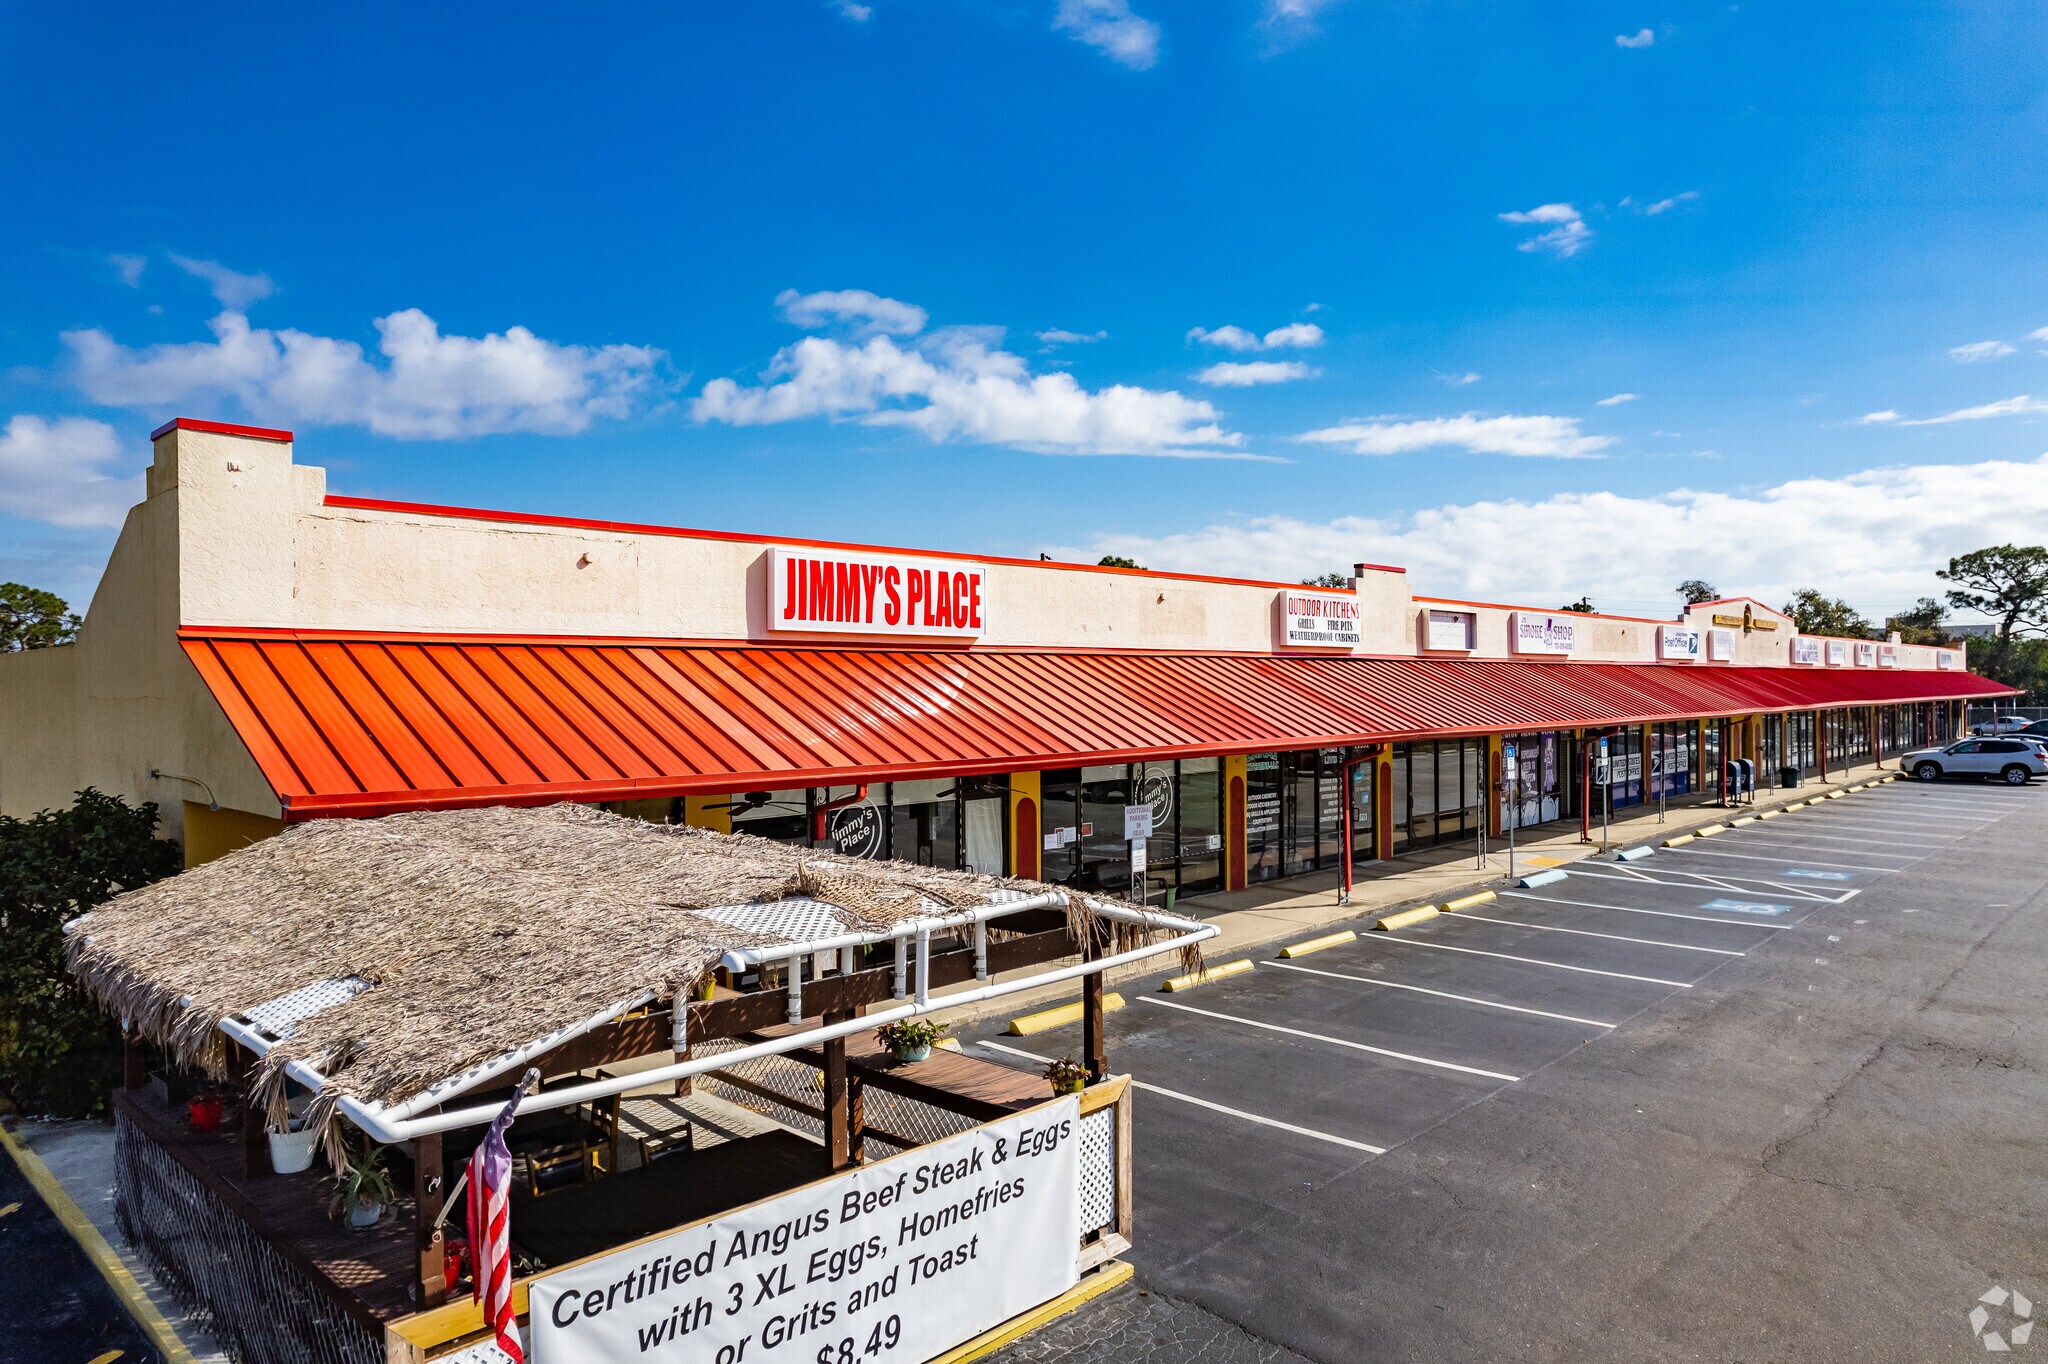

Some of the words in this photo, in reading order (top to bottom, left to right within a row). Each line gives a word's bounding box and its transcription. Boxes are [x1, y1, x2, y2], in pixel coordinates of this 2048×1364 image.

[784, 558, 900, 626] JIMMY'S
[907, 568, 981, 629] PLACE
[1288, 597, 1321, 617] OUTDOOR
[1323, 600, 1360, 619] KITCHENS
[1297, 618, 1315, 629] GRILLS
[1327, 620, 1339, 631] FIRE
[1340, 620, 1353, 631] PITS
[1289, 630, 1333, 641] WEATHERPROOF
[1334, 632, 1360, 643] CABINETS
[1519, 624, 1543, 639] SMOKE
[1553, 625, 1573, 641] SHOP
[1665, 636, 1675, 648] Post
[1675, 635, 1688, 648] Office
[1613, 759, 1626, 768] UNITED
[1628, 756, 1640, 766] STATES
[1617, 769, 1626, 778] POST
[1628, 767, 1640, 776] OFFICE
[1145, 780, 1167, 804] mmy's
[1126, 806, 1152, 815] ADDITIONAL
[1129, 814, 1148, 822] PARKING
[841, 826, 870, 852] Place
[1132, 829, 1145, 837] REAR
[552, 1239, 717, 1329] Certified
[724, 1208, 830, 1267] Angus
[840, 1172, 908, 1224] Beef
[912, 1146, 984, 1195] Steak
[991, 1137, 1008, 1165] &
[1015, 1119, 1071, 1158] Eggs
[638, 1296, 713, 1353] with
[725, 1282, 744, 1316] 3
[753, 1263, 796, 1307] XL
[806, 1235, 888, 1284] Eggs,
[898, 1177, 1025, 1247] Homefries
[715, 1325, 752, 1364] or
[761, 1300, 837, 1350] Grits
[847, 1265, 899, 1315] and
[908, 1233, 979, 1286] Toast
[817, 1314, 901, 1364] $8.49
